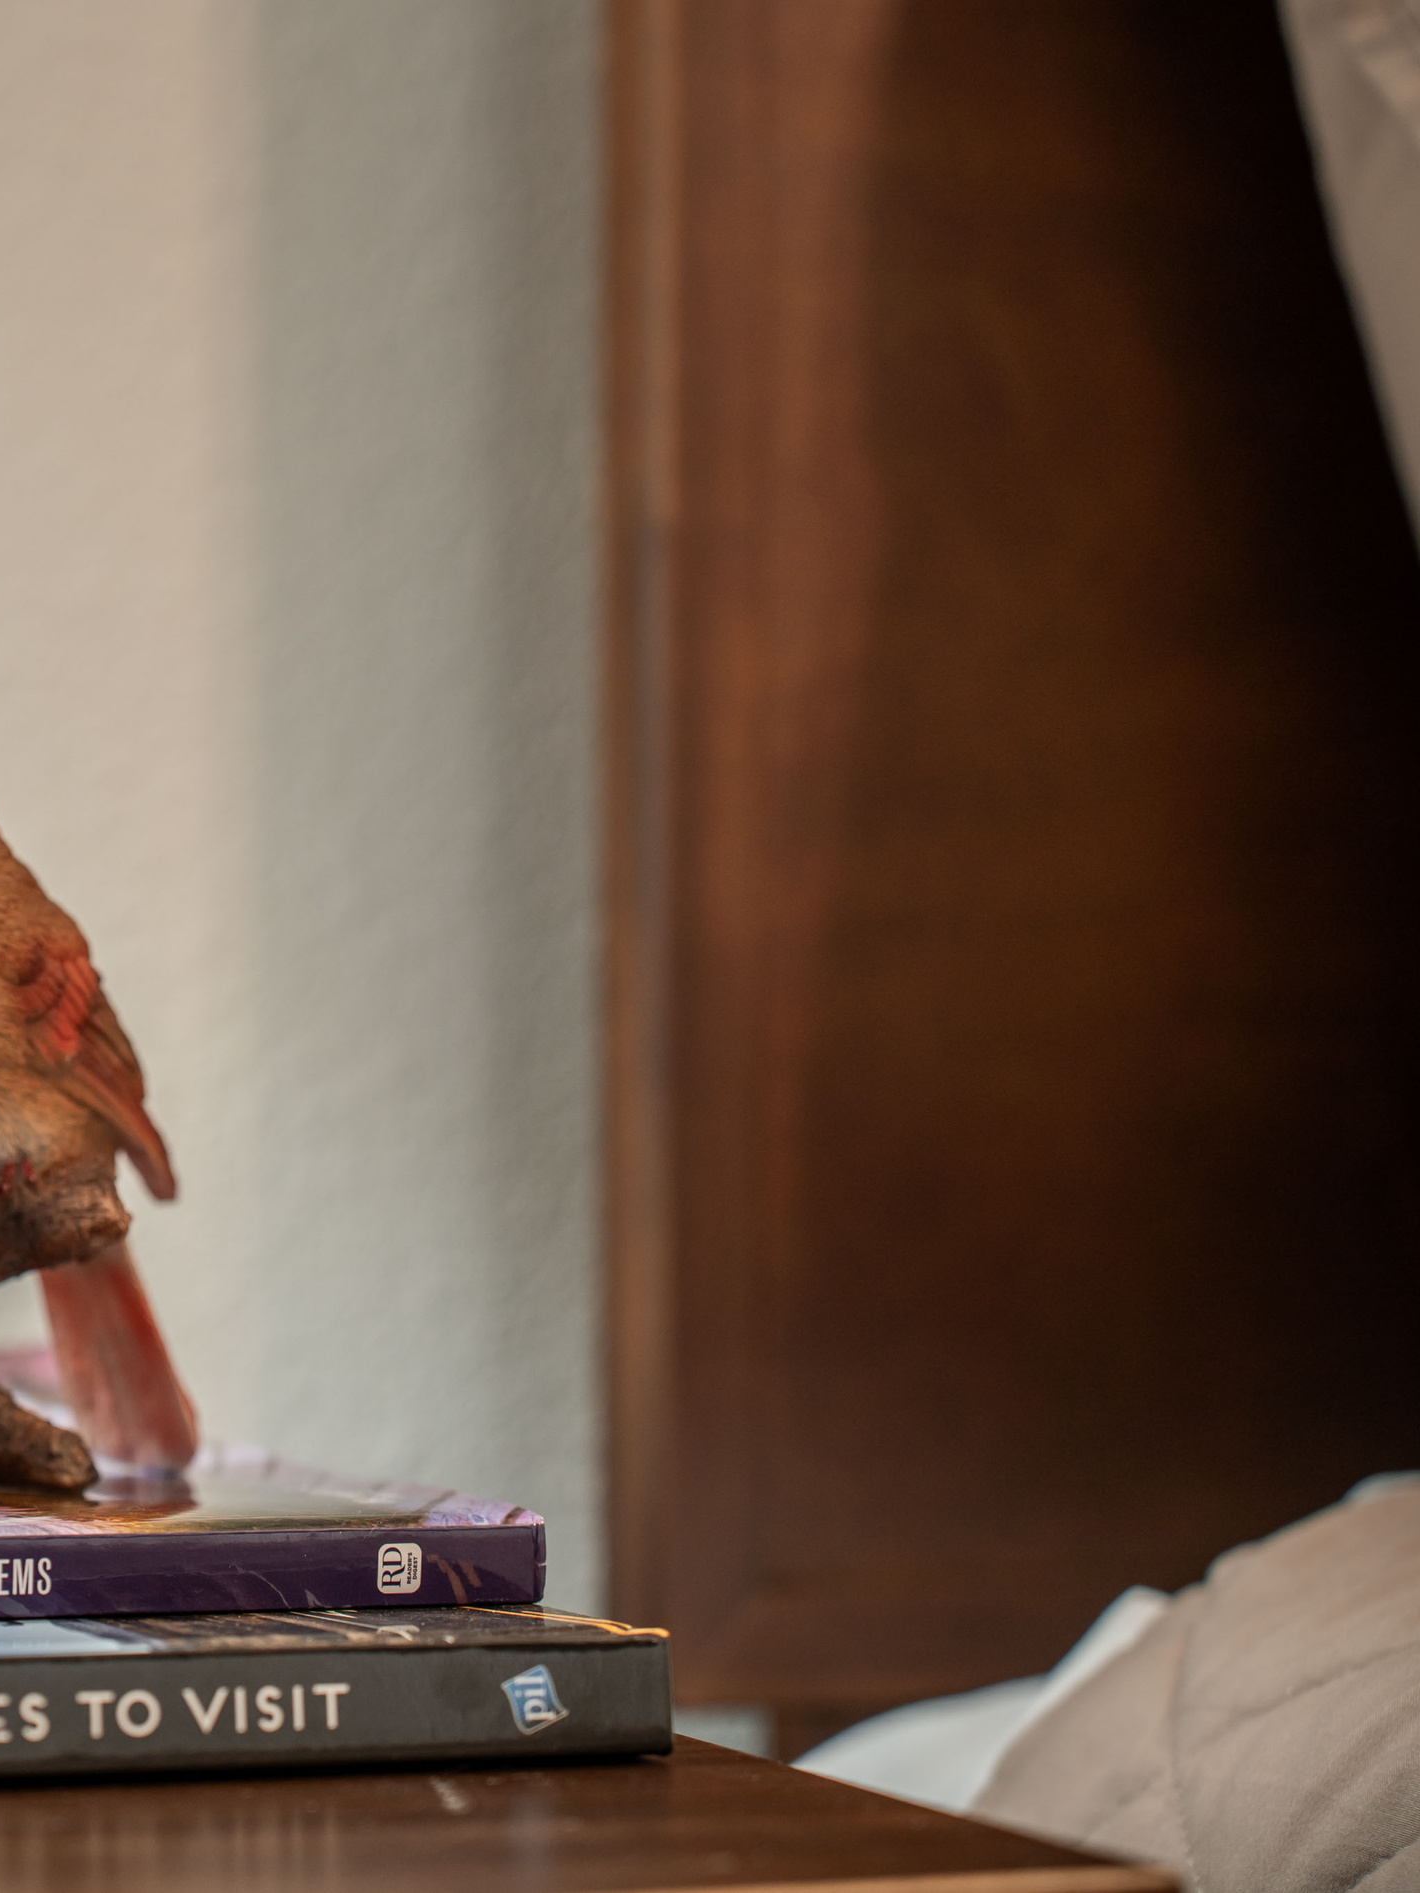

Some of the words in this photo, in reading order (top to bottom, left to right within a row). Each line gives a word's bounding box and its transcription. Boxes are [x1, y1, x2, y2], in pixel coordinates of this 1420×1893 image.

[381, 1546, 406, 1588] RD
[75, 1688, 163, 1739] TO
[182, 1682, 351, 1735] VISIT
[514, 1676, 557, 1722] pil
